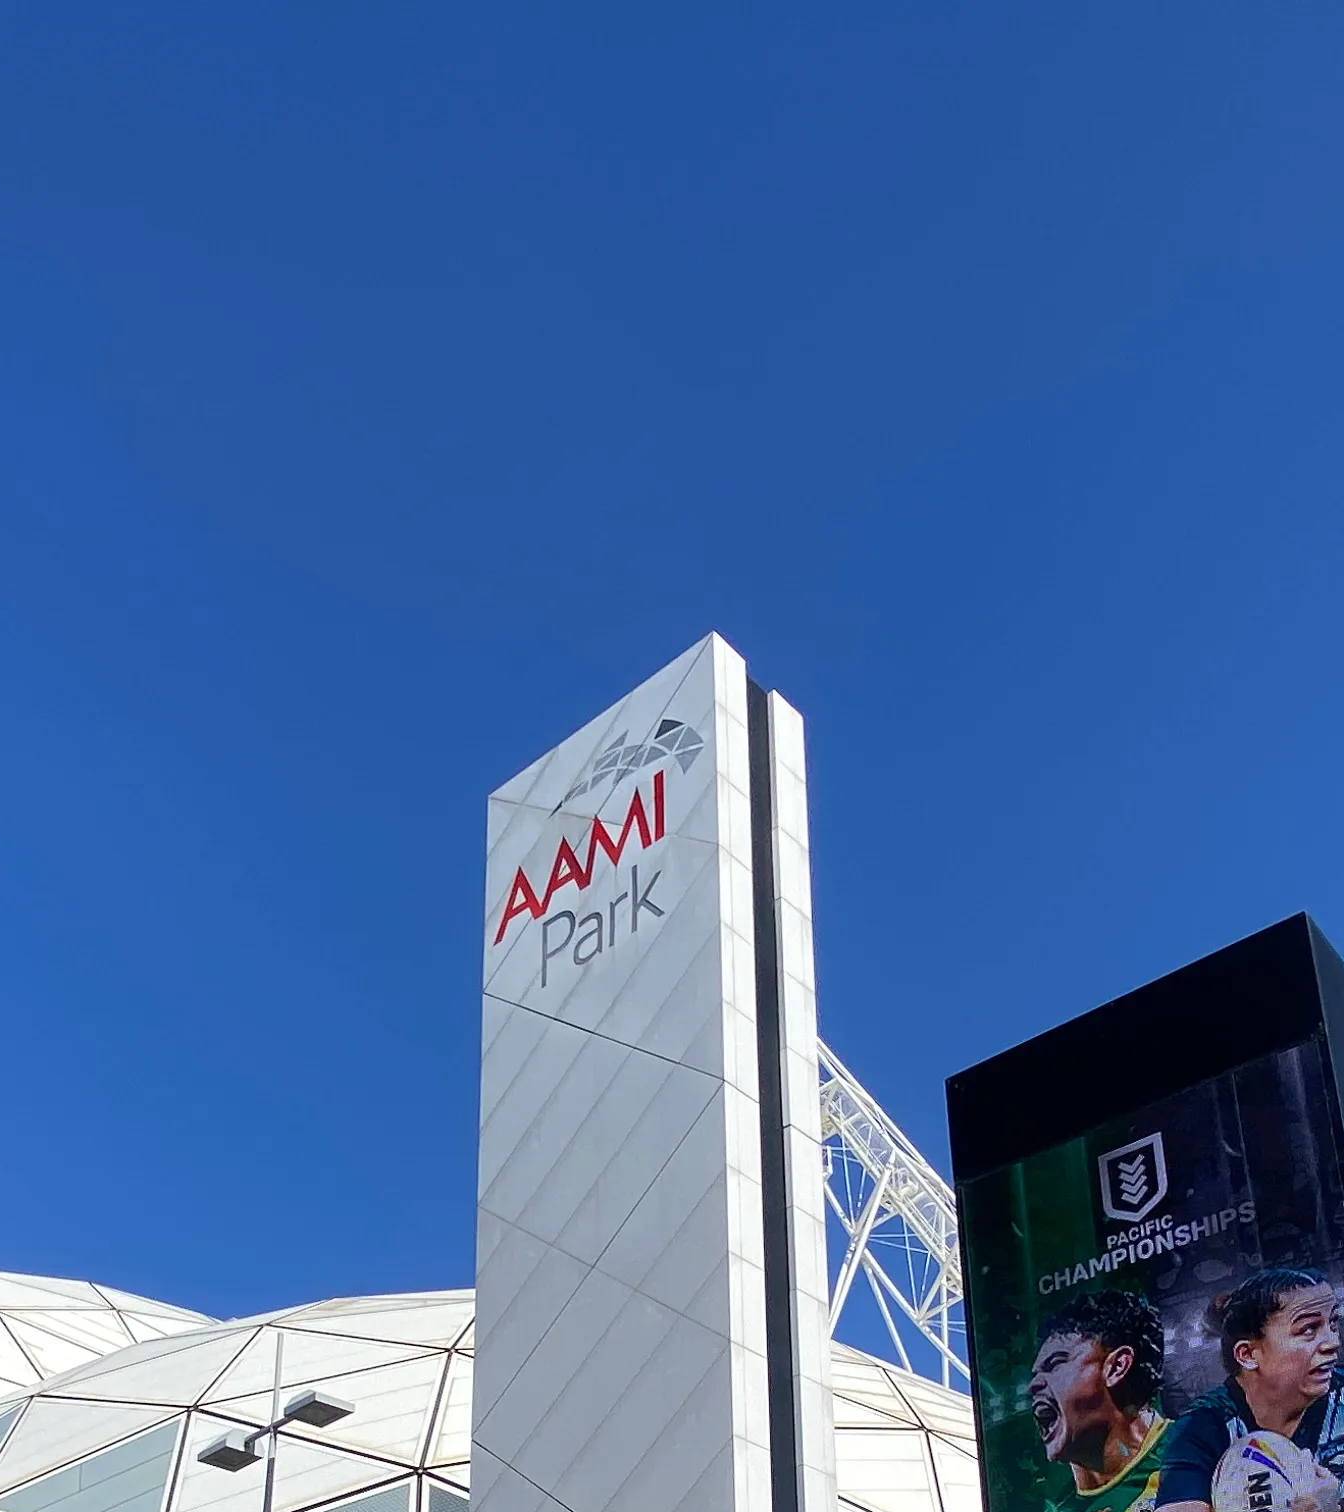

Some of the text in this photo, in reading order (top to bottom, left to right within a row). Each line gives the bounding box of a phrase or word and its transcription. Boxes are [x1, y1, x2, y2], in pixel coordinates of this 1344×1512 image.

[493, 769, 665, 946] AAMI
[541, 864, 665, 988] Park
[1038, 1200, 1256, 1295] CHAMPIONSHIPS
[1106, 1214, 1174, 1249] PACIFIC
